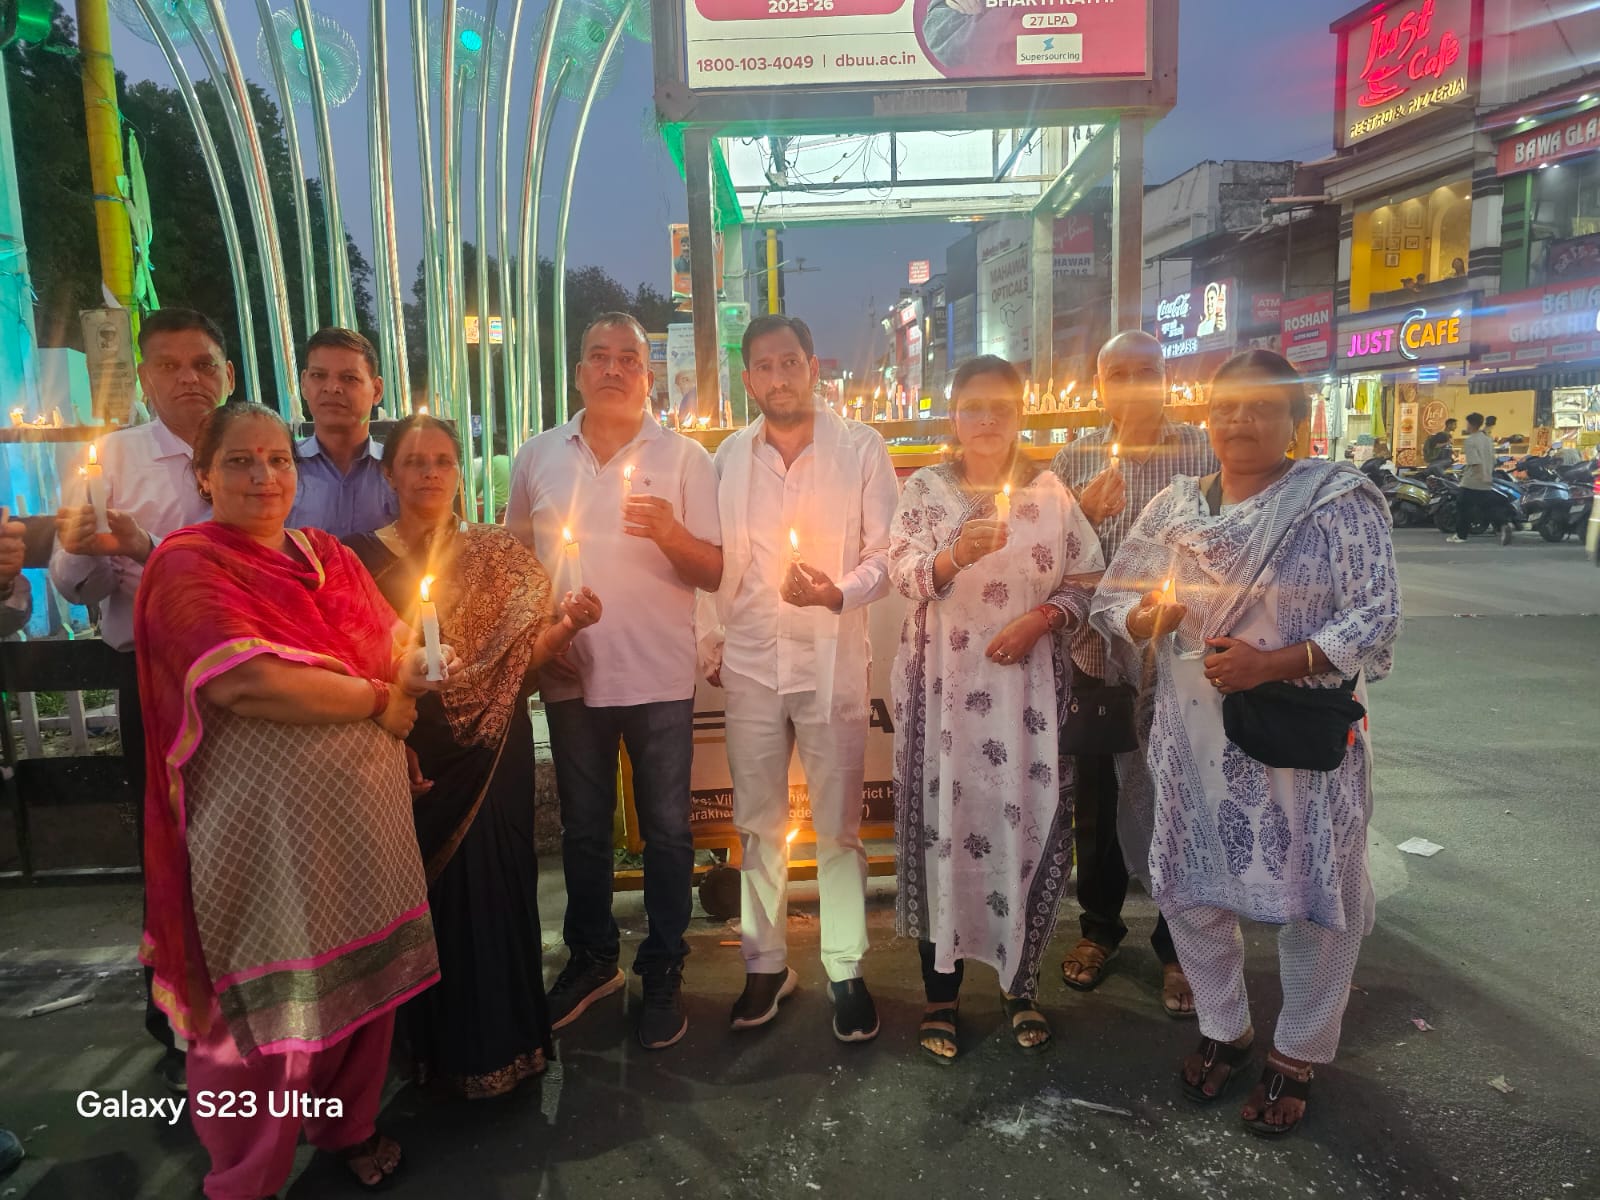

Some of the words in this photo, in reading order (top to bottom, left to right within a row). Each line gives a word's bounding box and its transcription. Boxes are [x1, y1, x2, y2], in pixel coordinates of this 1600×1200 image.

[768, 0, 834, 13] 2025-26
[1030, 16, 1044, 26] 27
[1047, 15, 1069, 26] LPA
[1360, 0, 1435, 79] Just
[696, 55, 814, 72] 1800-103-4049
[835, 51, 916, 68] dbuu.ac.in
[1020, 51, 1080, 63] Supersourcing
[1515, 130, 1561, 163] BAWA
[1565, 117, 1600, 147] GLA
[991, 276, 1029, 304] OPTICALS
[1284, 310, 1329, 333] ROSHAN
[1347, 329, 1395, 358] JUST
